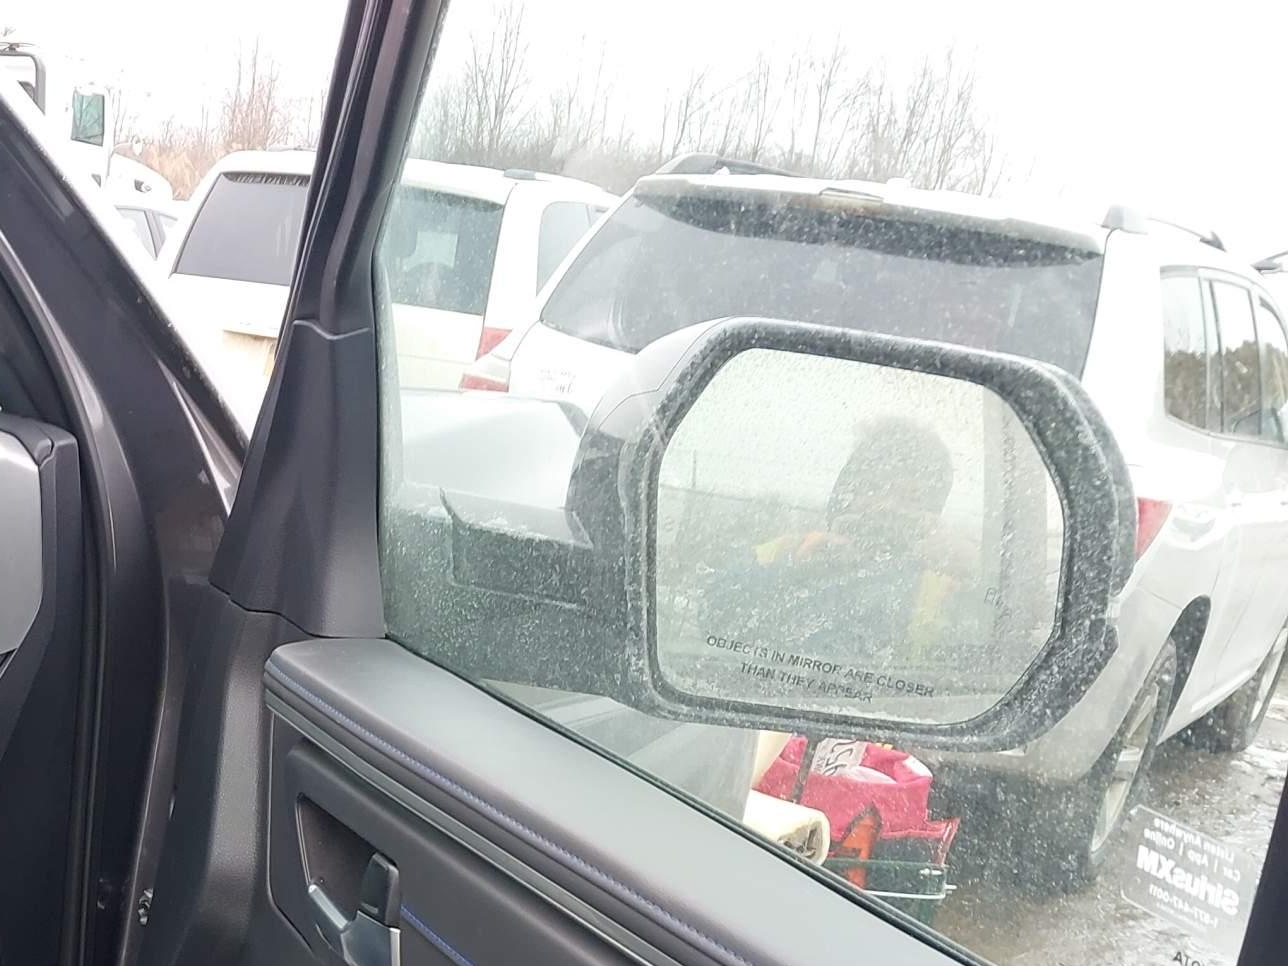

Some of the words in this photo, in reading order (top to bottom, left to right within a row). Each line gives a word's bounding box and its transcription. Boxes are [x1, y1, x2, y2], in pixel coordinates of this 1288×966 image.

[706, 634, 768, 660] OBJECTS
[771, 650, 787, 665] IN
[788, 654, 842, 675] MIRROR
[844, 667, 875, 684] ARE
[876, 675, 935, 698] CLOSER
[740, 662, 776, 680] THAN
[779, 670, 815, 690] THEY
[818, 680, 872, 703] APPEAR
